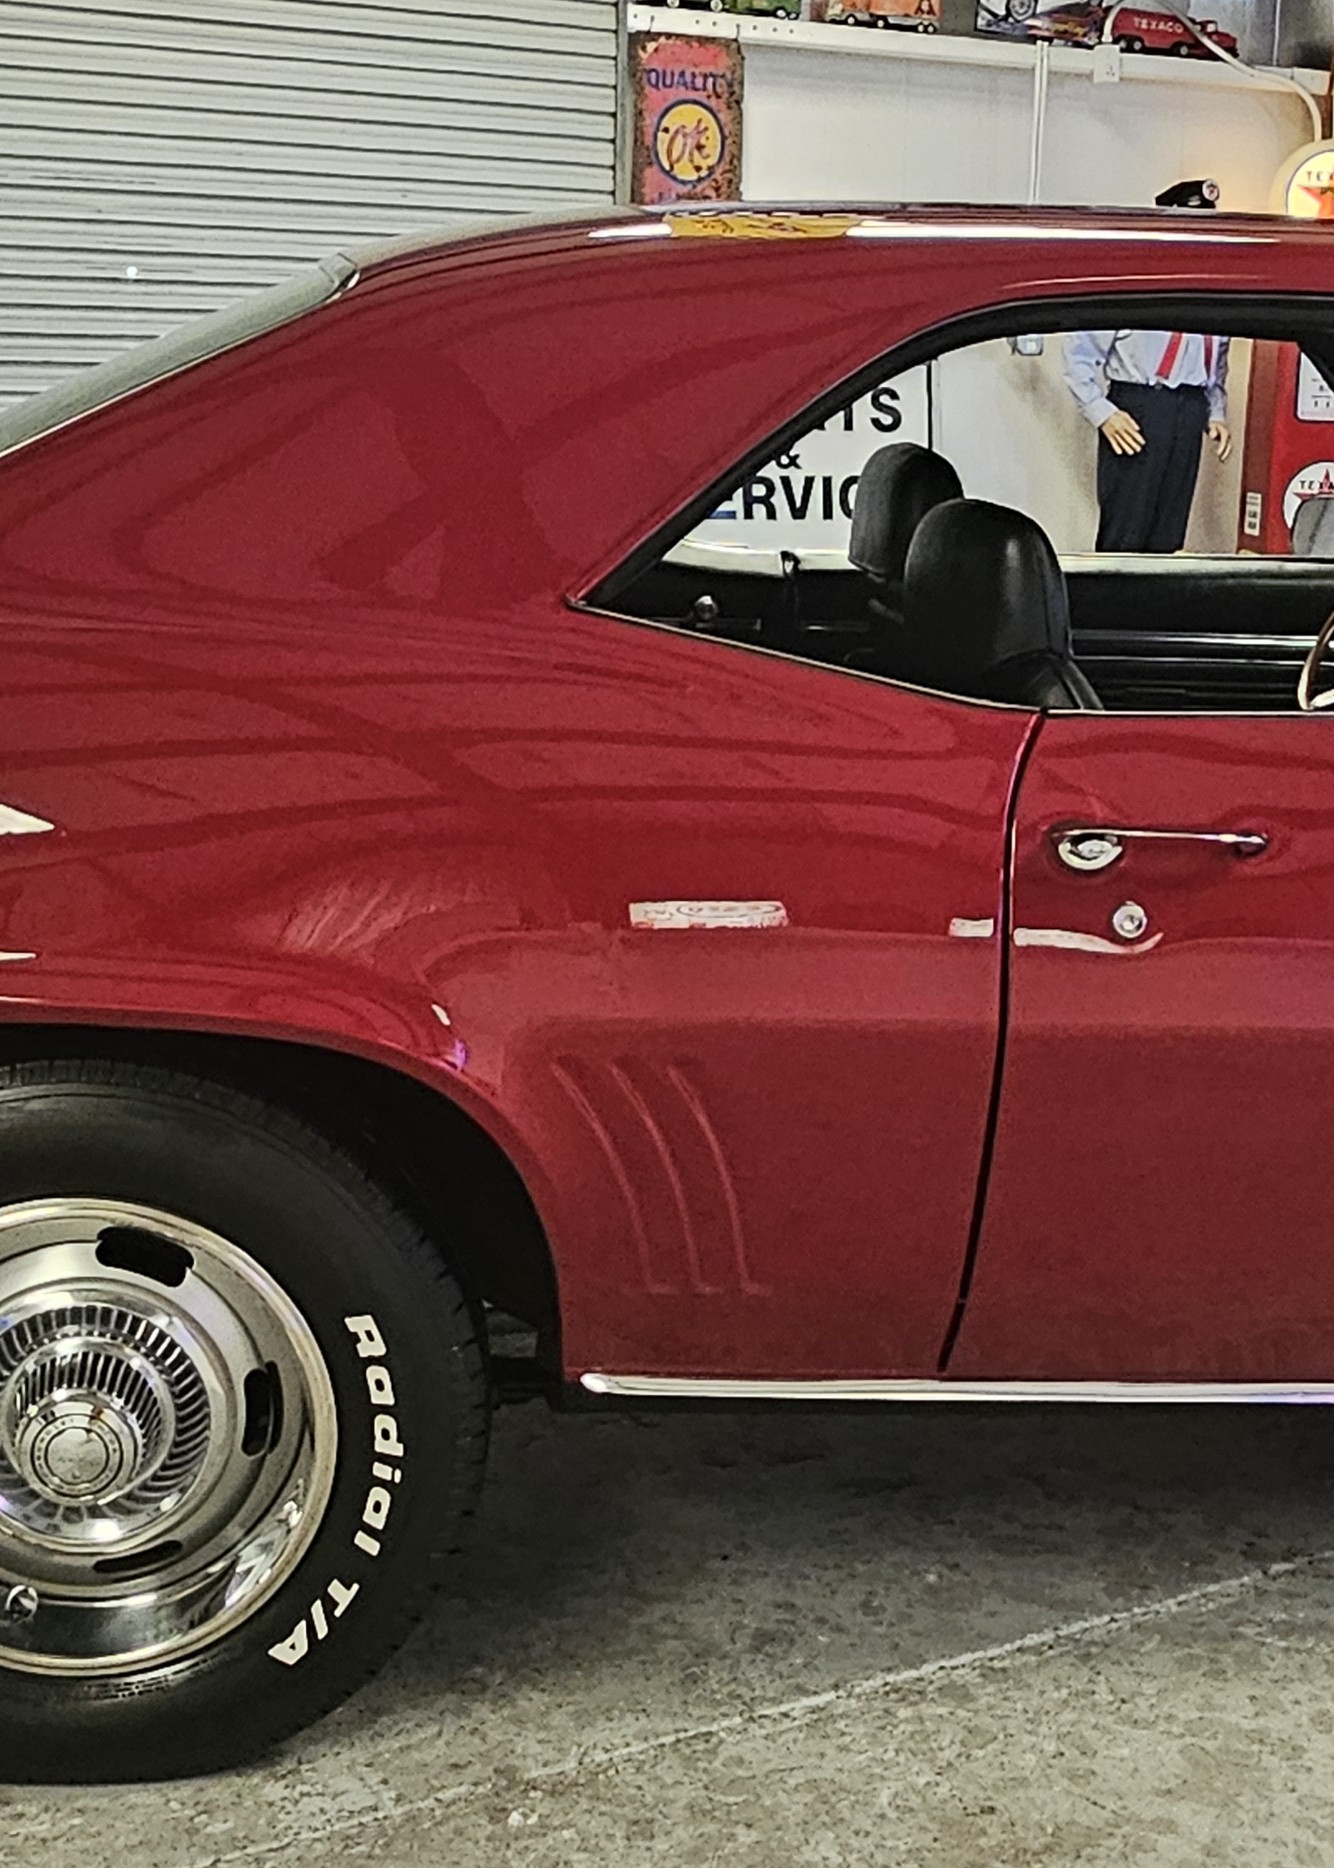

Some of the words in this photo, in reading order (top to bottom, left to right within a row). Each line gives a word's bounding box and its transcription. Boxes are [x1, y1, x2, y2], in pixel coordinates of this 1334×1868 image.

[1133, 16, 1184, 34] TEXACO
[646, 67, 737, 98] QUALITY
[708, 475, 861, 521] RVIC
[344, 1314, 404, 1557] Radial
[267, 1578, 360, 1666] T/A
